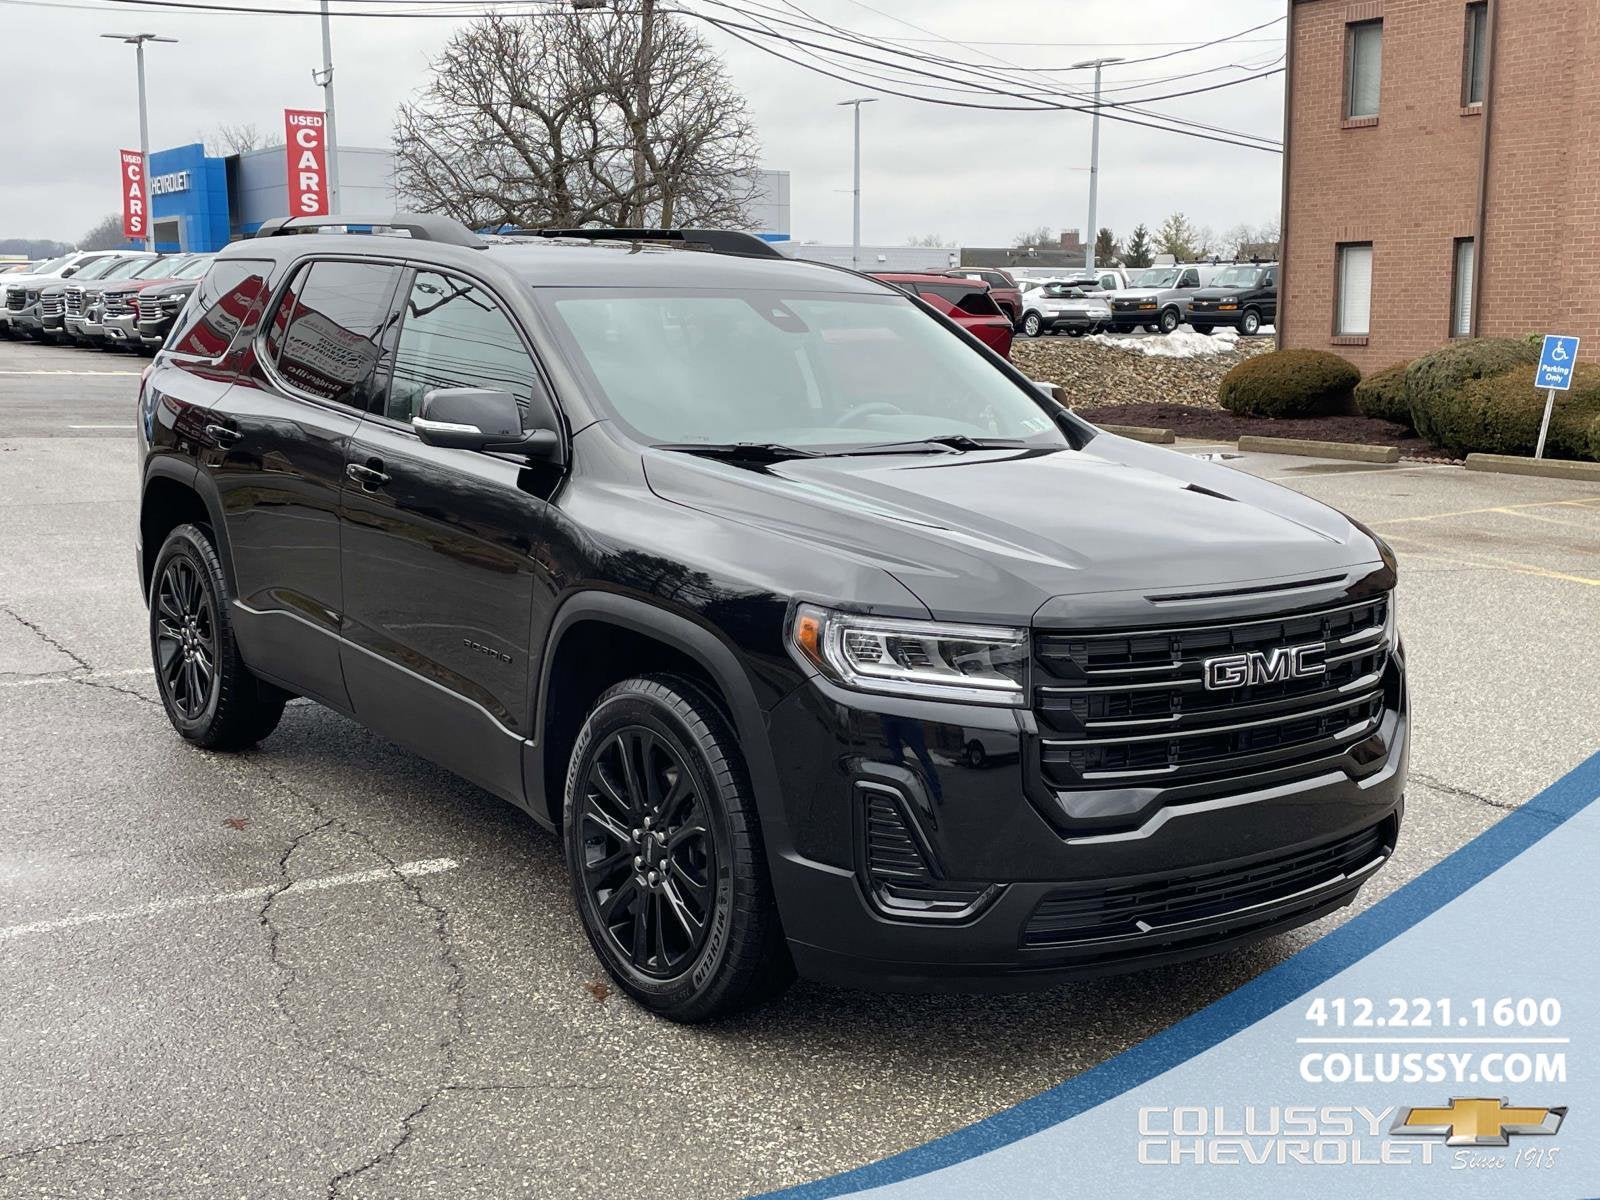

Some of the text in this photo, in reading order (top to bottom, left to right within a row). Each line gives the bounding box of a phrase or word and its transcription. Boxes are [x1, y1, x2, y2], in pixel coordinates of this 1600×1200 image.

[289, 115, 323, 127] USED
[122, 153, 142, 164] USED
[296, 128, 320, 213] CARS
[127, 165, 142, 232] CARS
[150, 170, 190, 195] HEVROLET
[1541, 364, 1569, 376] Parking
[1545, 373, 1563, 384] Only
[1204, 642, 1327, 691] GMC
[566, 726, 590, 800] MICHELIN
[694, 909, 726, 986] MICHELIN
